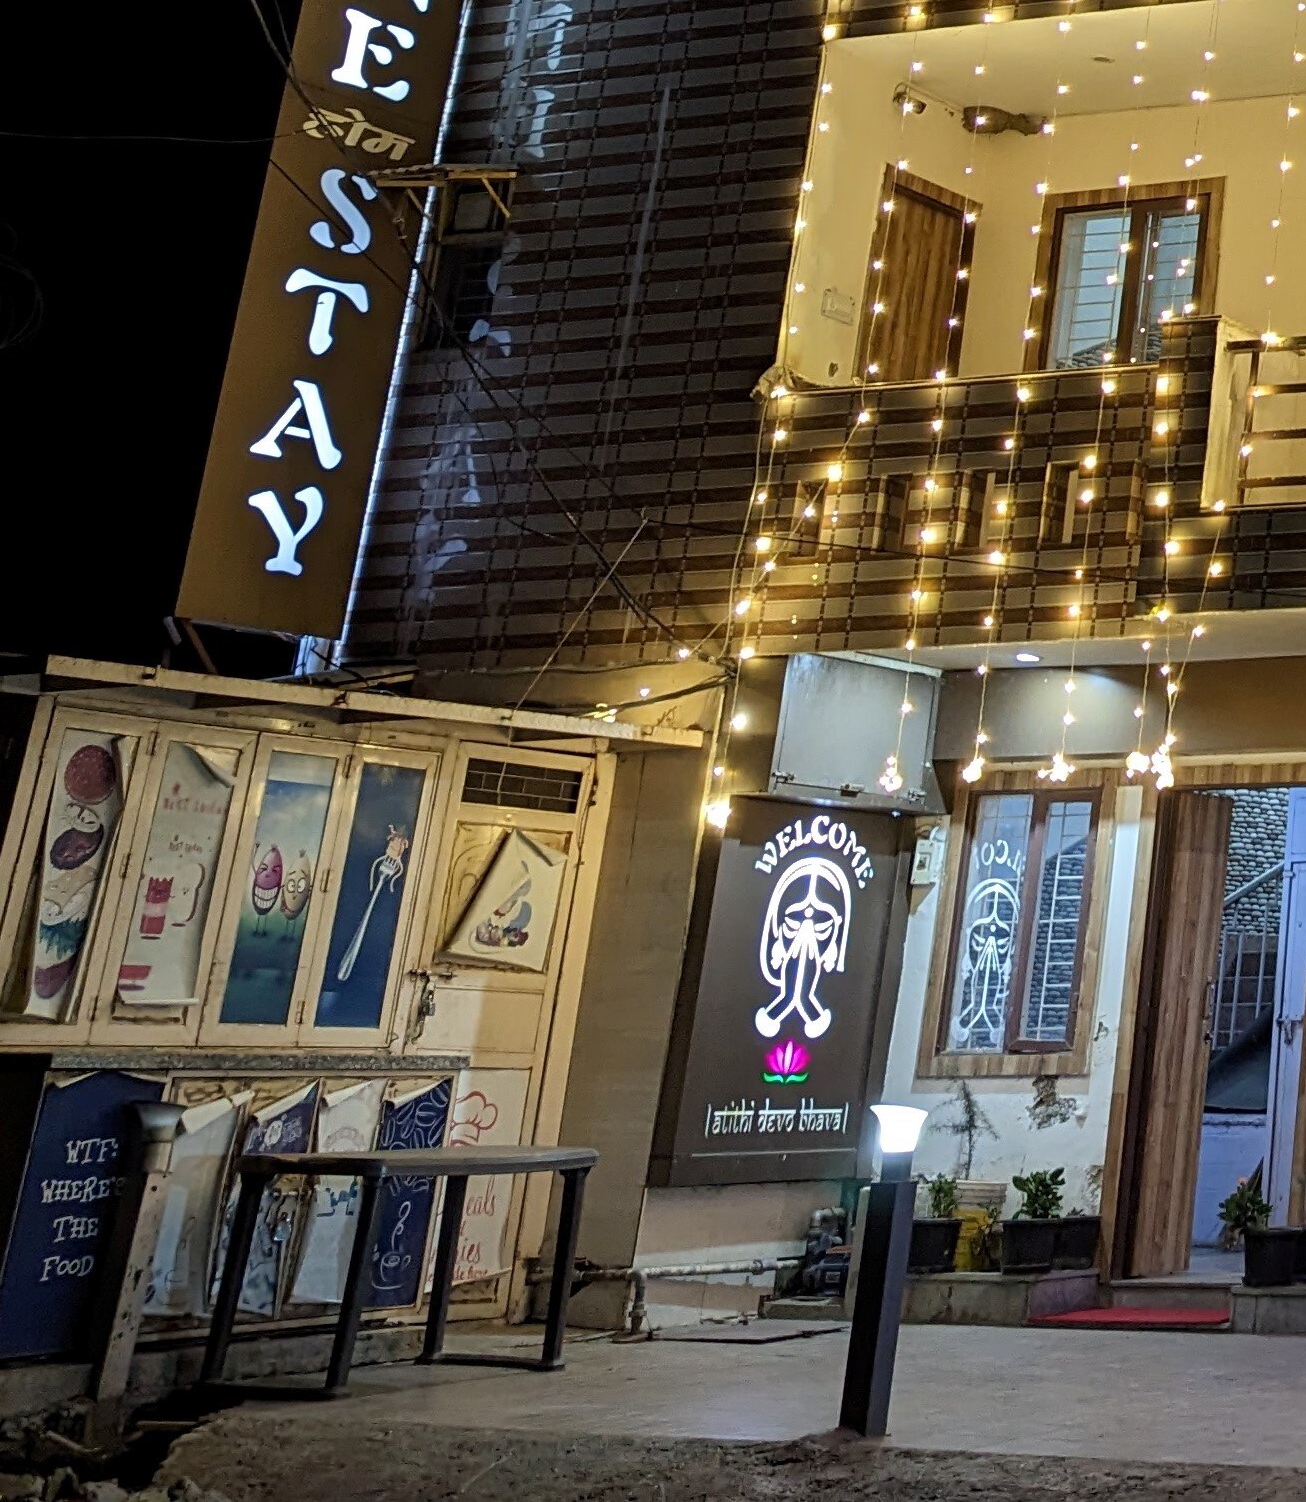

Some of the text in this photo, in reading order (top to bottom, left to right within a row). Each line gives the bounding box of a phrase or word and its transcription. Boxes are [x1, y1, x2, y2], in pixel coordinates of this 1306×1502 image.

[303, 107, 416, 161] होम
[247, 166, 379, 577] STAY
[755, 815, 874, 889] WELCOME
[65, 1138, 119, 1165] WTF:
[53, 1215, 99, 1243] THE
[39, 1255, 95, 1283] FOOD
